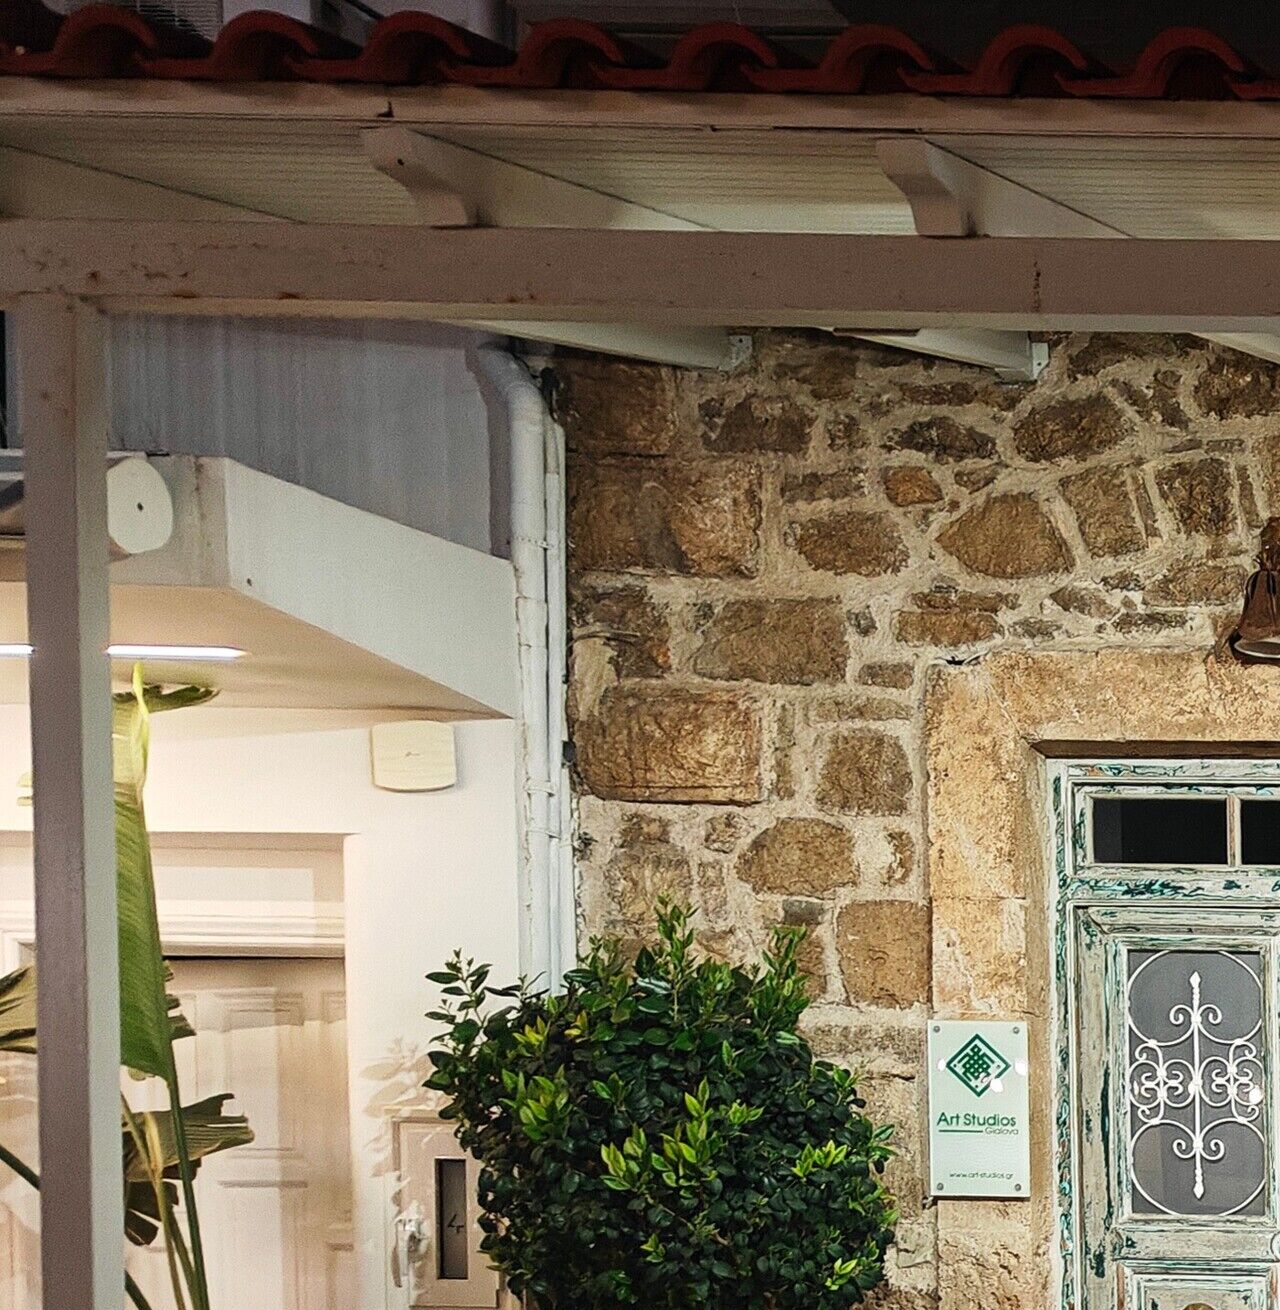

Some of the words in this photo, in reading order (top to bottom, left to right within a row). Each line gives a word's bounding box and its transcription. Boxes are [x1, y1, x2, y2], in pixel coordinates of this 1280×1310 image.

[936, 1112, 961, 1126] Art
[963, 1113, 1017, 1127] Studios
[447, 1213, 465, 1234] 4
